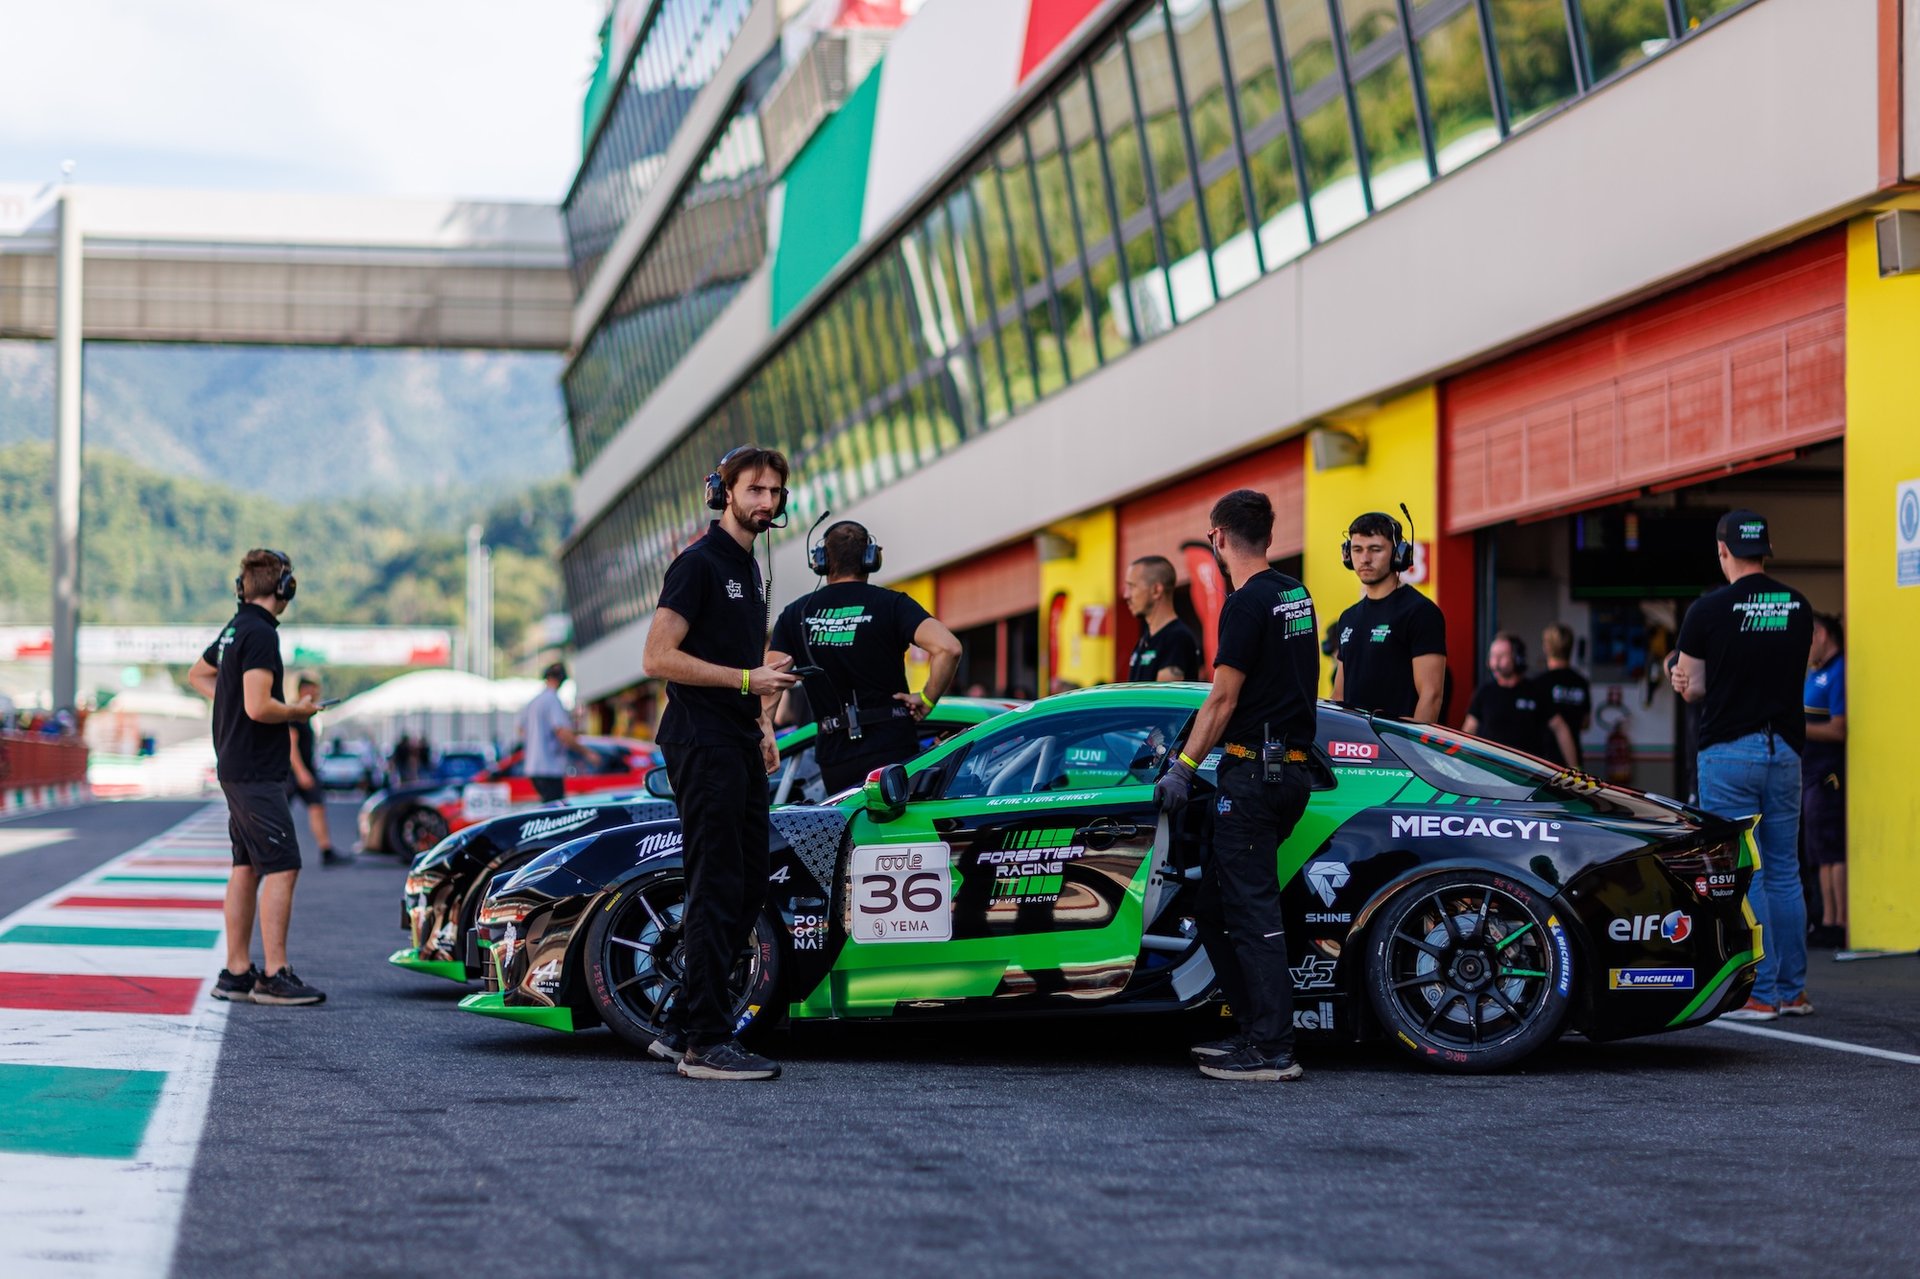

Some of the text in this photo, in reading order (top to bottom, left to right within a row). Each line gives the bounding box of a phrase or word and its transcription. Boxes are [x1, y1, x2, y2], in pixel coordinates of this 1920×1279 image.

[1084, 605, 1106, 636] 7
[811, 624, 857, 632] RACING
[1071, 749, 1102, 761] JUN
[1334, 742, 1372, 757] PRO
[1334, 768, 1415, 778] R.MEYUHAS
[519, 808, 598, 839] Milwaukee
[976, 845, 1085, 864] FORESTIER
[995, 861, 1063, 877] RACING
[1709, 874, 1735, 885] GSVI
[860, 872, 942, 915] 36
[1025, 895, 1058, 903] RACING
[1305, 913, 1351, 923] SHINE
[891, 921, 929, 932] YEMA
[1608, 914, 1661, 941] elf
[1556, 935, 1570, 991] MICHELIN
[1634, 975, 1684, 983] MICHELIN
